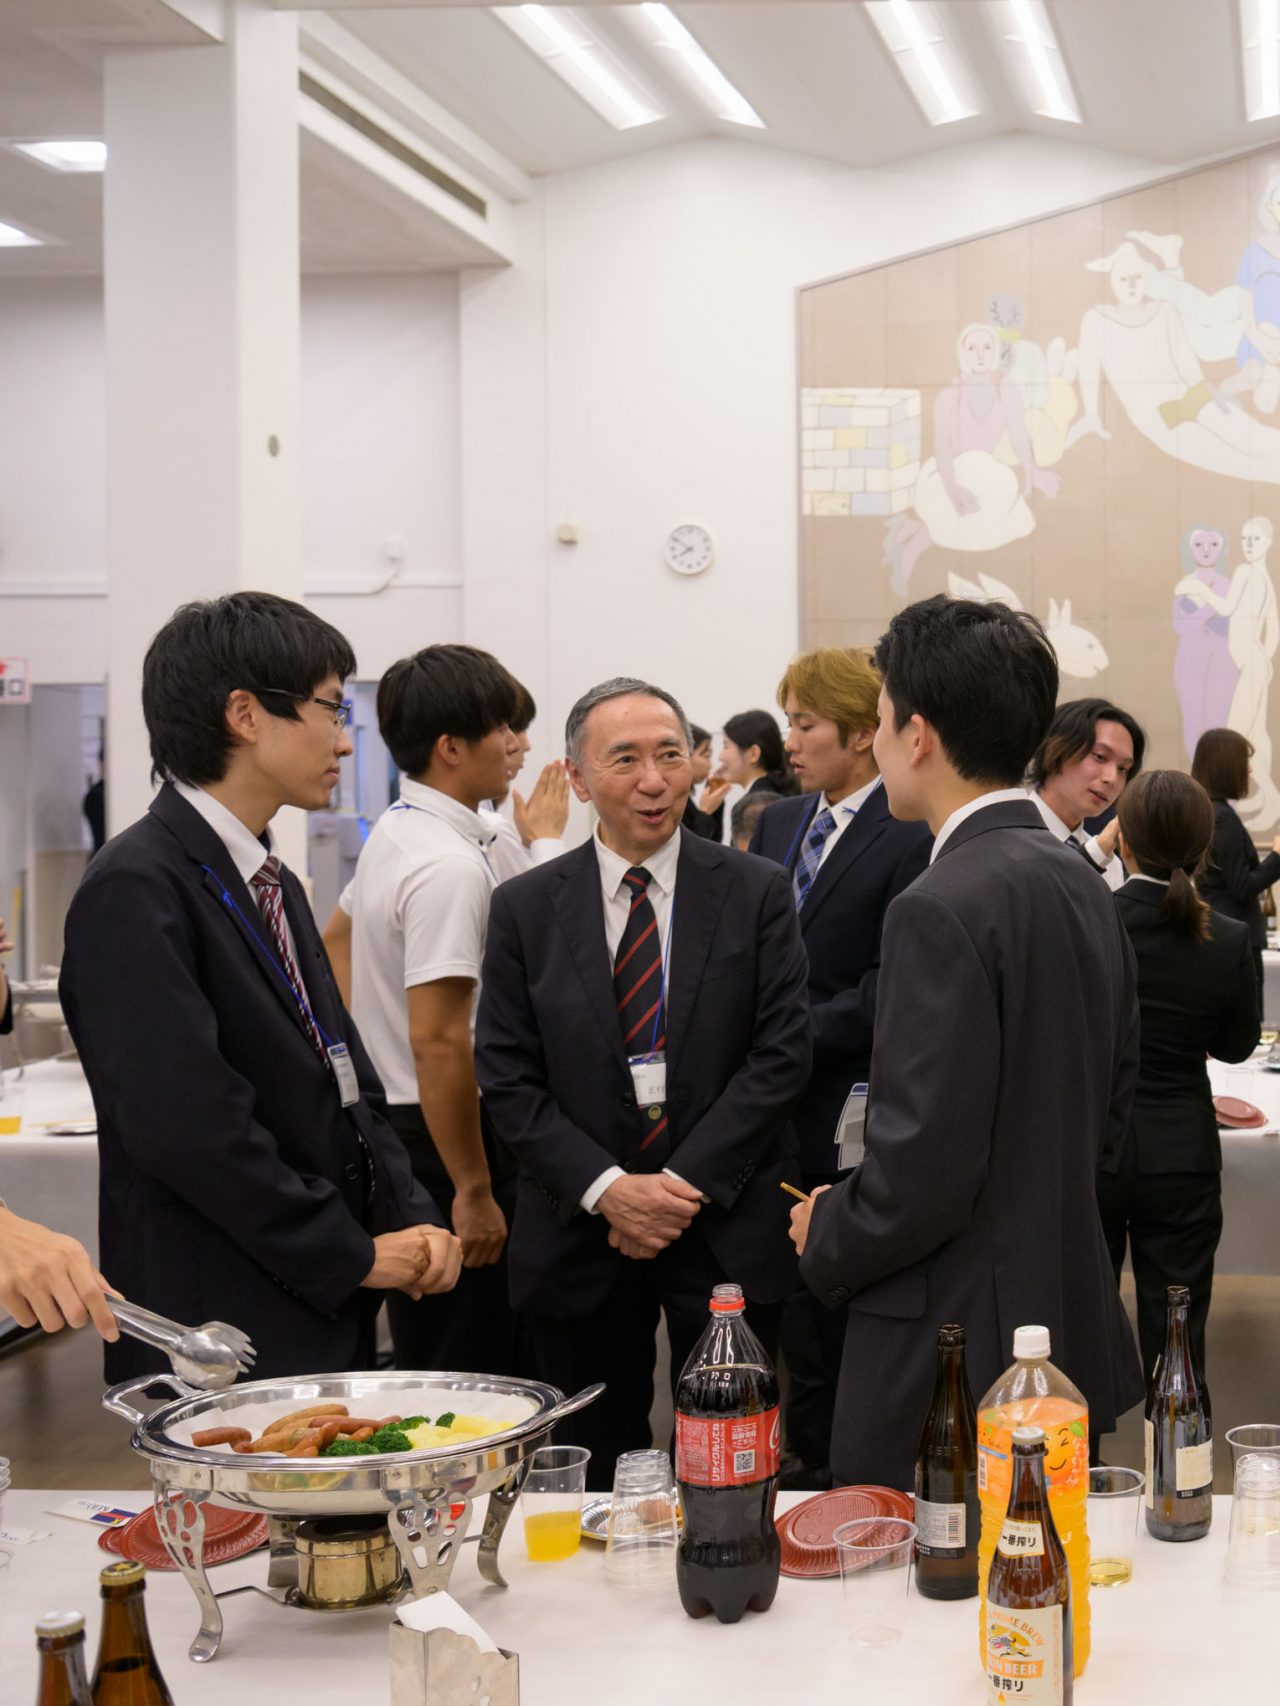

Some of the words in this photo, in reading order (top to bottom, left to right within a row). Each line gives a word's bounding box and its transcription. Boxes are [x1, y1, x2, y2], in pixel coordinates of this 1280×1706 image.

[1002, 1534, 1036, 1548] 一番搾り
[1021, 1622, 1046, 1647] BREW
[1004, 1662, 1037, 1675] BEER
[988, 1673, 1024, 1692] 一番搾り
